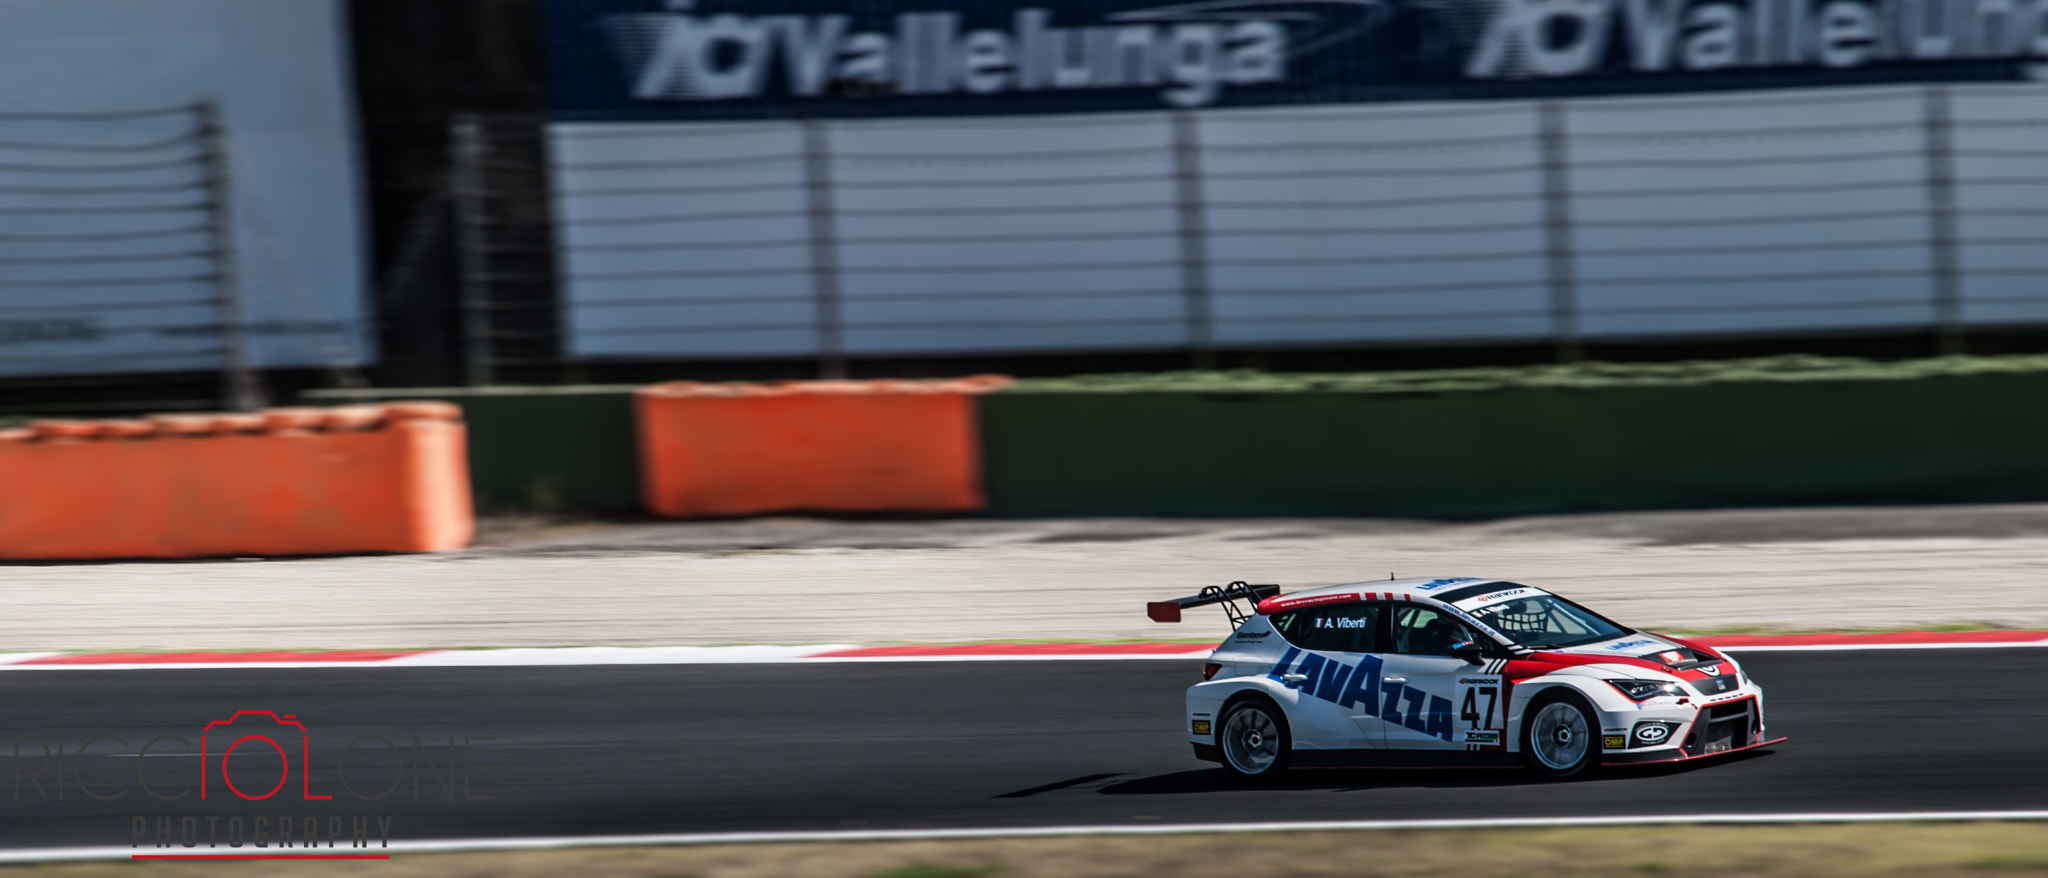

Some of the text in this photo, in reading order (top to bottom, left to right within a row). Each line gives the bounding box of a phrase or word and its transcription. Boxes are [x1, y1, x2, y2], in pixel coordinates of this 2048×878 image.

[778, 8, 1287, 105] Vallelunga
[1324, 617, 1366, 629] A. Viberti
[1267, 646, 1453, 742] LAVAZZA
[1461, 686, 1498, 731] 47
[1604, 738, 1624, 746] OMP
